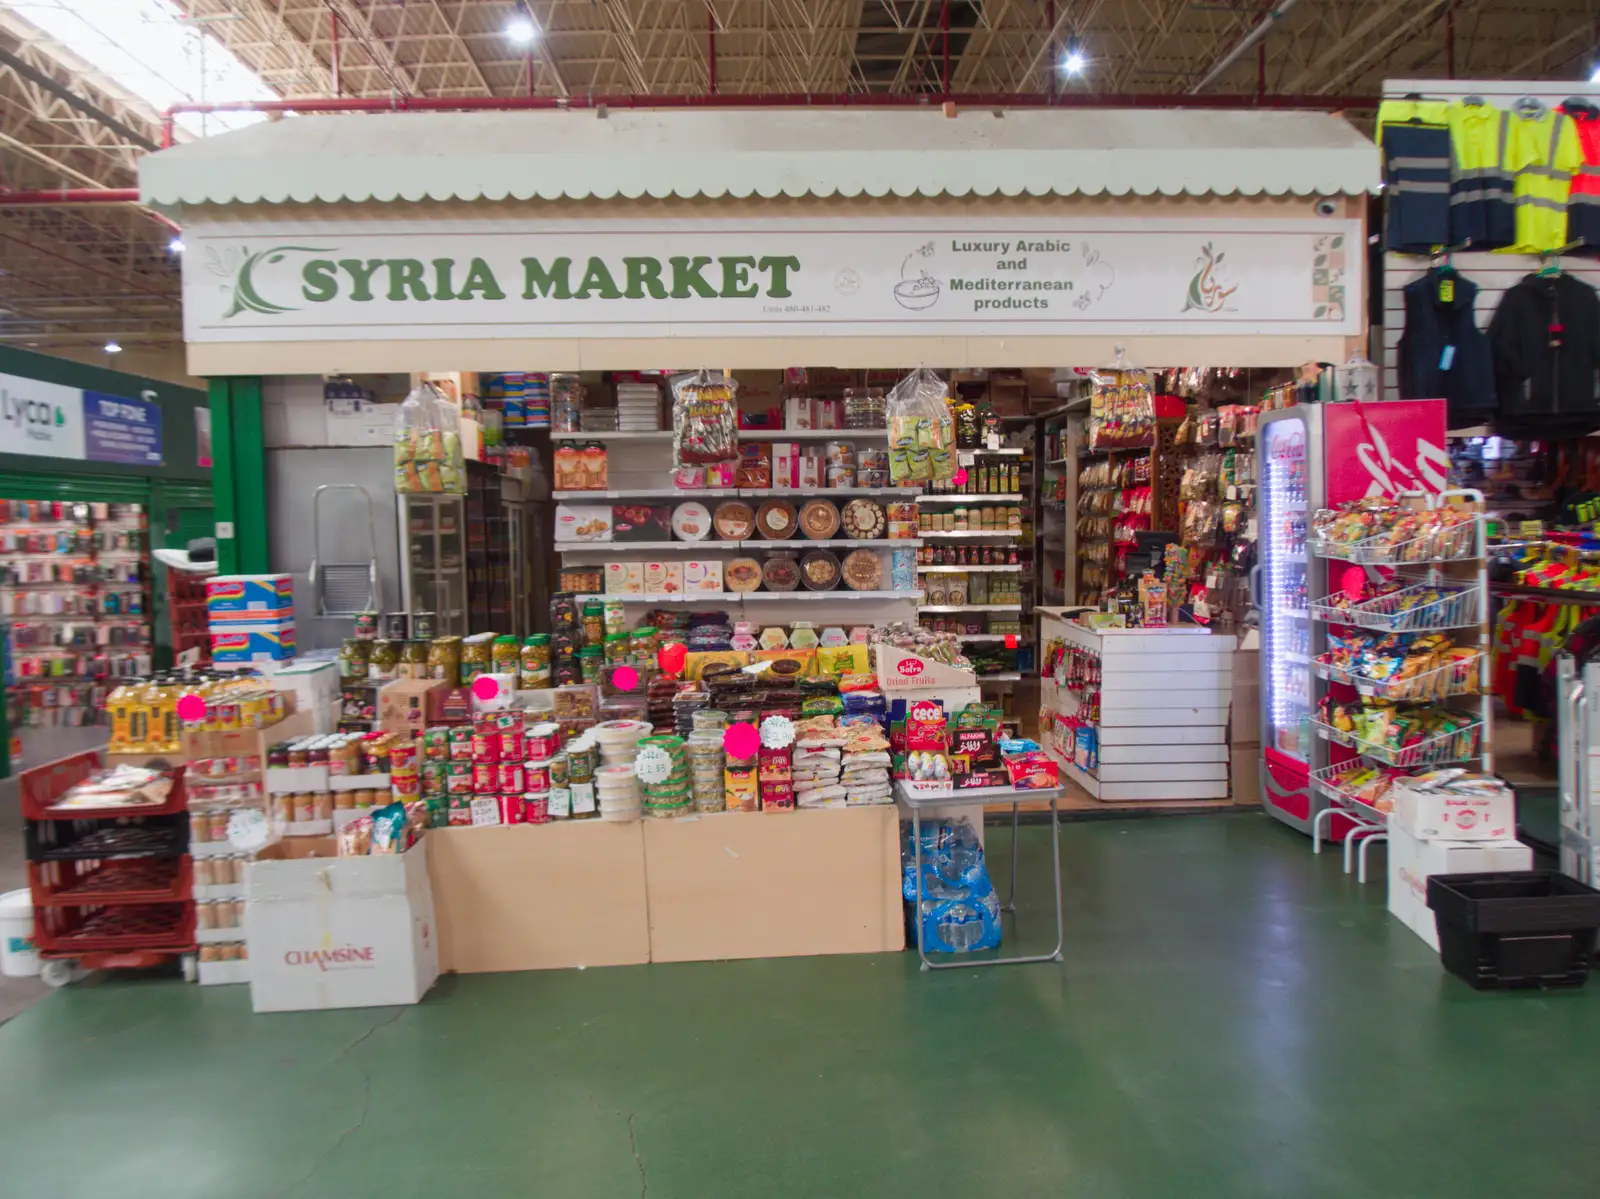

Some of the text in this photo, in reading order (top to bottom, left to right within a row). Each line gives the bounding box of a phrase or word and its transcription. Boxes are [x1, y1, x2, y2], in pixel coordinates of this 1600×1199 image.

[952, 240, 1071, 254] Luxury Arabic
[996, 258, 1027, 270] and
[301, 255, 801, 302] SYRIA MARKET
[950, 279, 1073, 290] Mediterranean
[974, 297, 1048, 311] products
[899, 665, 922, 674] Sofra
